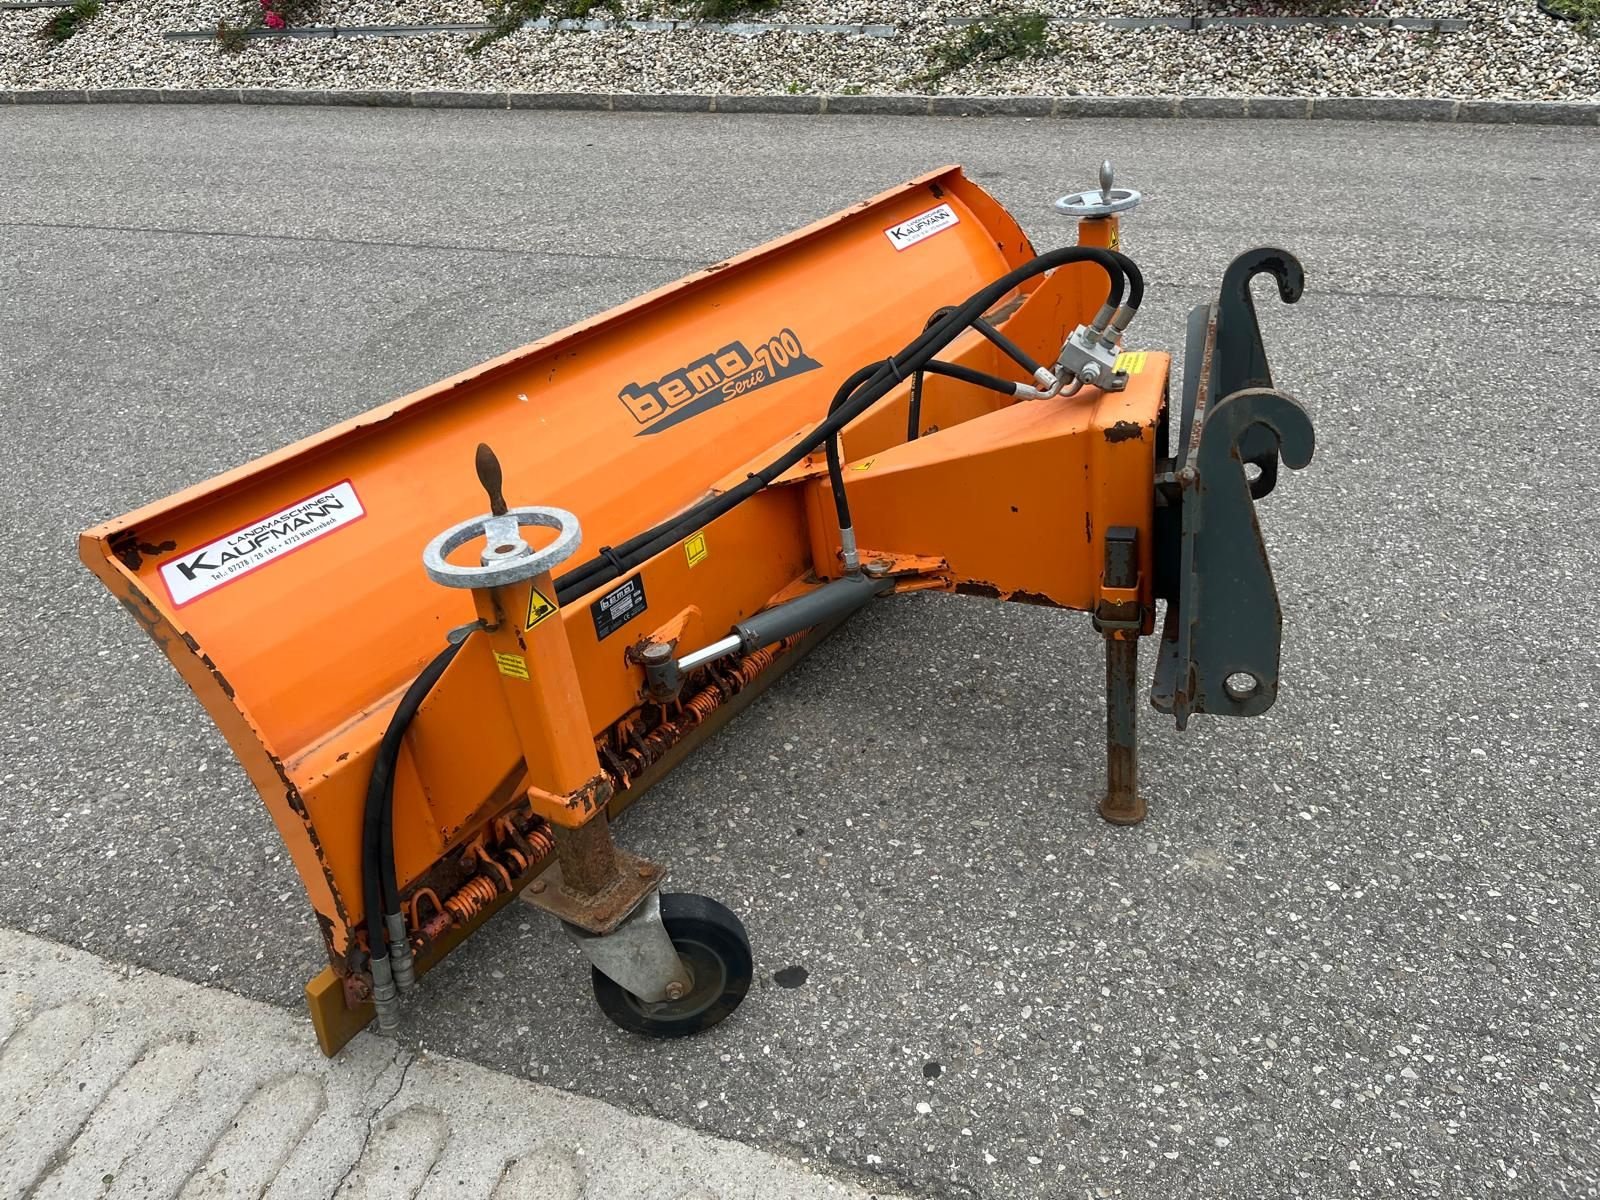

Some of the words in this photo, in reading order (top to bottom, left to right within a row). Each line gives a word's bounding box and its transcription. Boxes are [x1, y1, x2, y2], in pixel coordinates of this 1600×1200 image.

[890, 210, 950, 240] KAUFMANN
[618, 340, 754, 424] bema
[721, 369, 766, 402] Serie
[754, 327, 803, 378] 700
[176, 498, 345, 581] KAUFMANN
[211, 570, 228, 581] Tel.:
[228, 559, 250, 573] 07278
[254, 552, 264, 560] 20
[265, 545, 277, 557] 165
[284, 534, 300, 545] 4723
[300, 517, 337, 538] Natternbach
[227, 493, 336, 546] LANDMASCHINEN
[600, 580, 635, 611] bema
